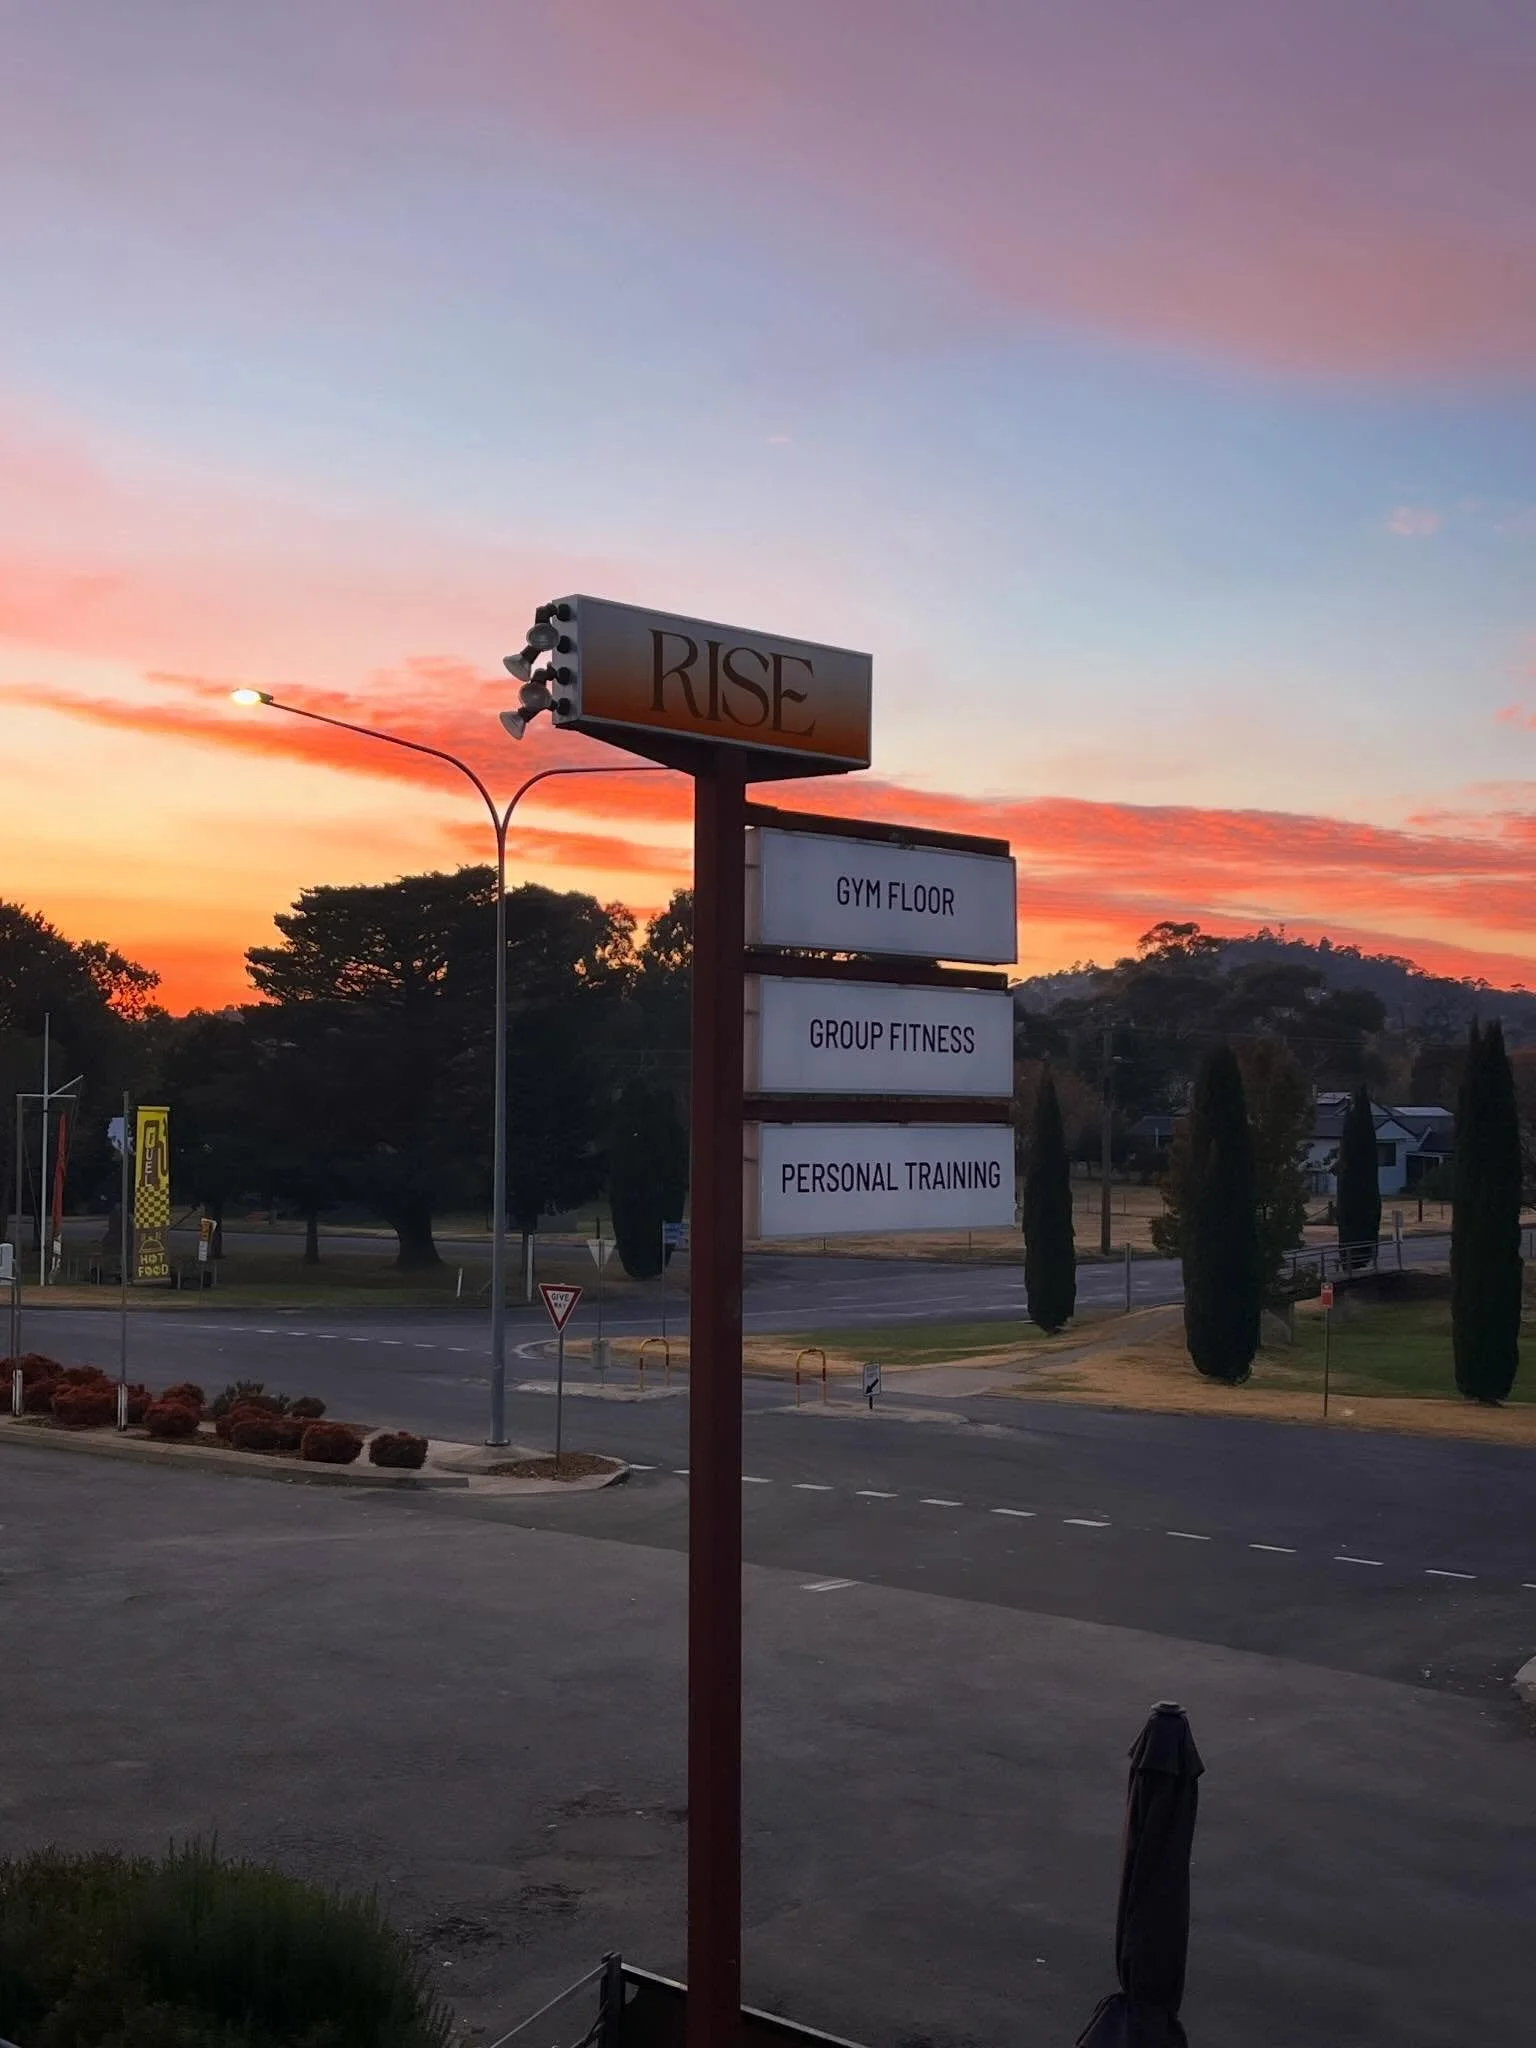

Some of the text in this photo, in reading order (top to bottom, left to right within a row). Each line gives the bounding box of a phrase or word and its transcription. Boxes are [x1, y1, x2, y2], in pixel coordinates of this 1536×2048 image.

[649, 629, 815, 736] RISE
[837, 876, 955, 916] GYM FLOOR
[810, 1019, 975, 1054] GROUP FITNESS
[782, 1160, 1001, 1193] PERSONAL TRAINING
[138, 1264, 169, 1277] FOOD
[139, 1253, 165, 1264] HOT
[551, 1293, 569, 1301] GIVE
